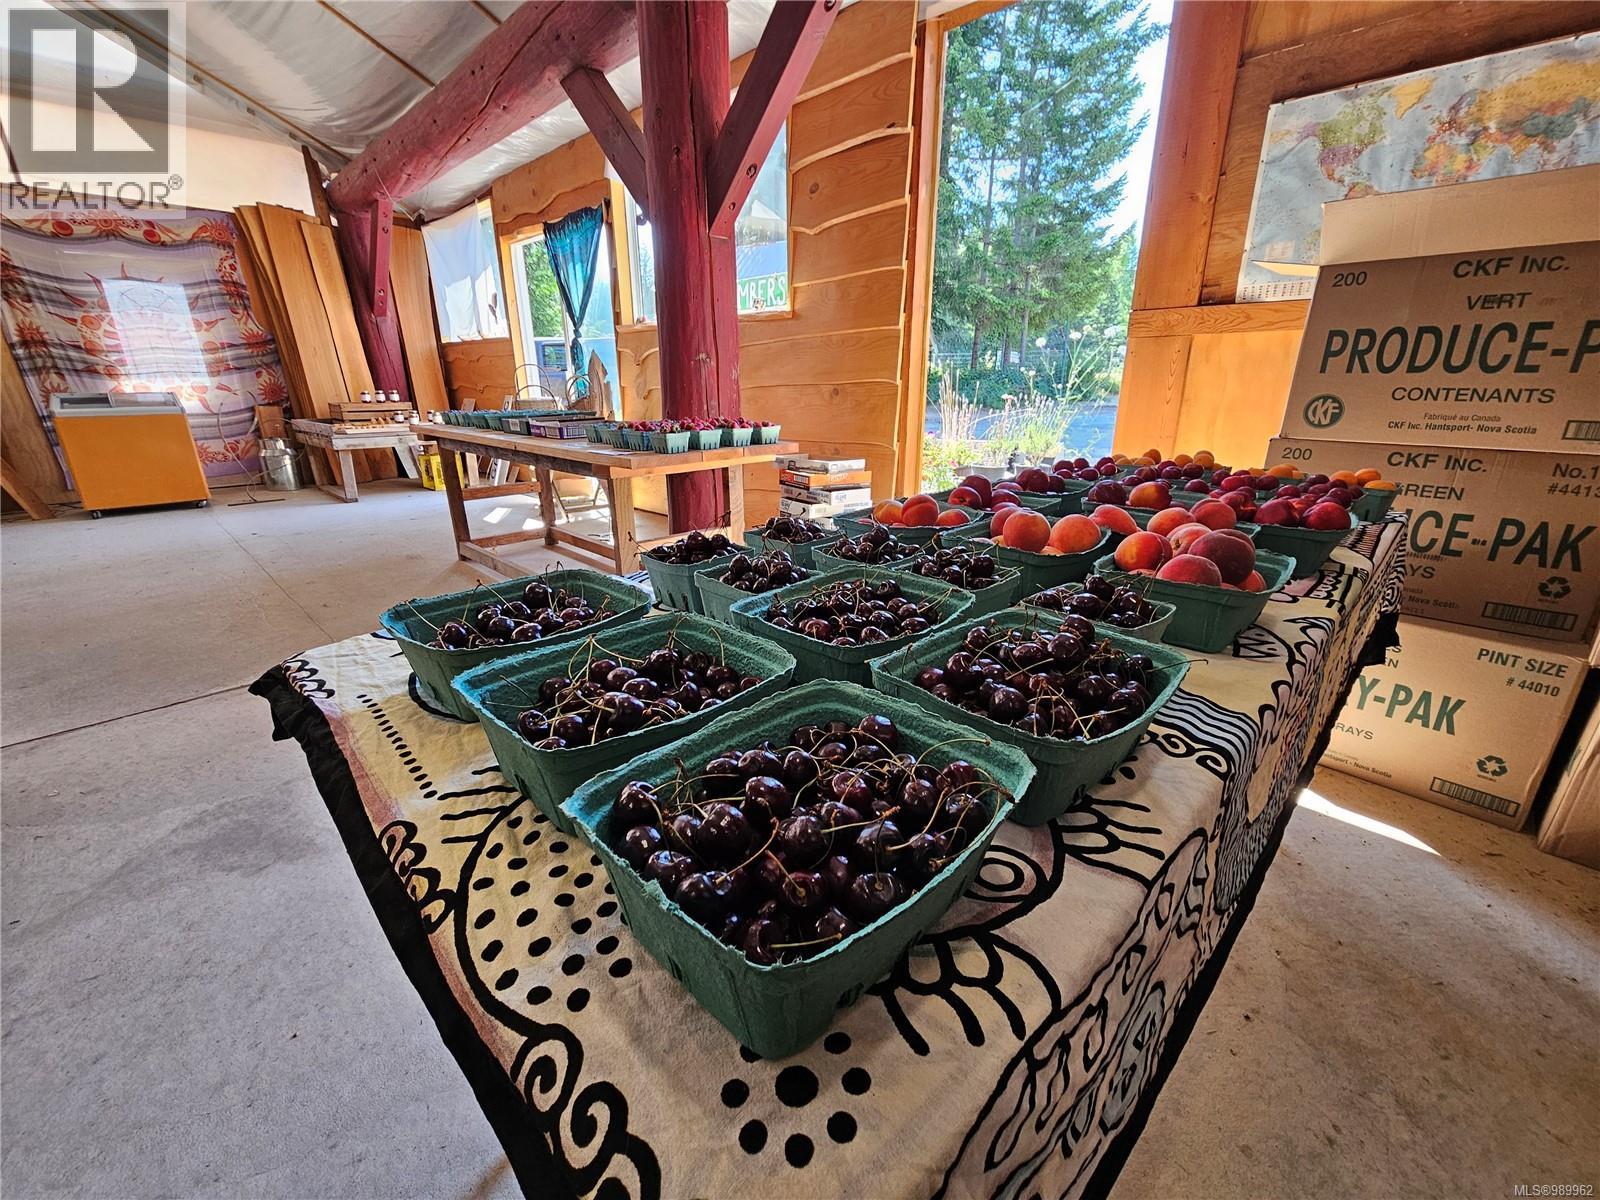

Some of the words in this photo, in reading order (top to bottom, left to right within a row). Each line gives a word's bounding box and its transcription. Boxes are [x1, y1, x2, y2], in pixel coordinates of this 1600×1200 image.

[1452, 256, 1513, 278] CKF
[1519, 255, 1571, 274] INC.
[1332, 271, 1368, 288] 200
[1466, 291, 1533, 311] VERT
[1319, 319, 1600, 375] PRODUCE-P
[1391, 386, 1557, 403] CONTENANTS
[1307, 398, 1342, 427] CKF
[1471, 414, 1502, 423] Canada
[1388, 421, 1406, 430] CKF
[1476, 424, 1502, 433] Nova
[1504, 425, 1537, 435] Scotia
[1281, 447, 1313, 461] 200
[1387, 451, 1439, 469] CKF
[1445, 454, 1488, 473] INC.
[1405, 508, 1598, 573] CE-PAK
[1477, 648, 1522, 669] PINT
[1525, 658, 1569, 679] SIZE
[1518, 680, 1560, 697] 44010
[1355, 674, 1466, 736] Y-PAK
